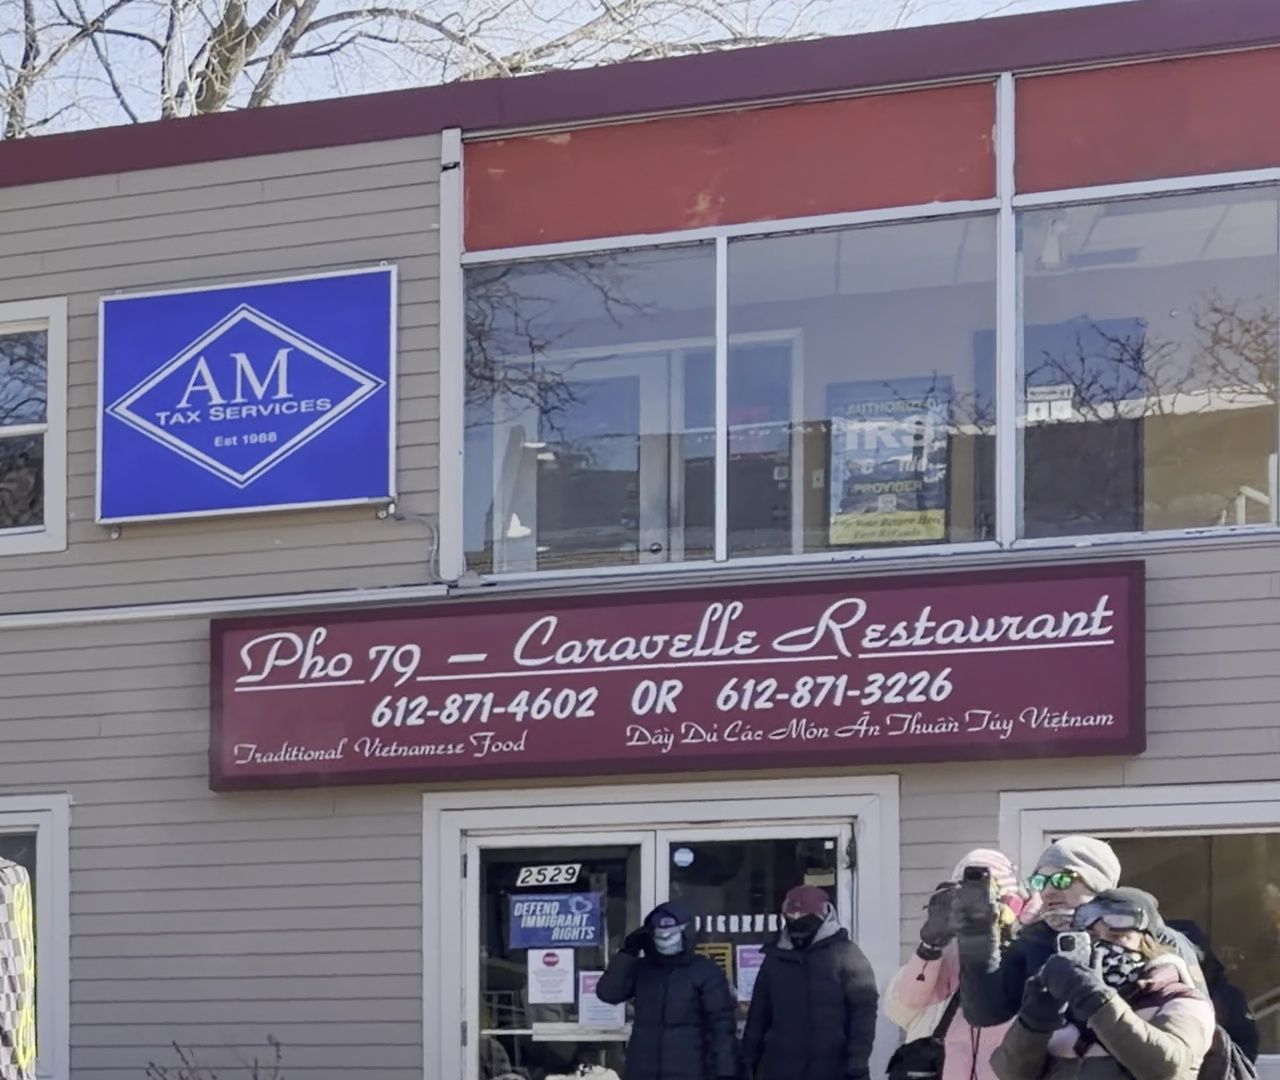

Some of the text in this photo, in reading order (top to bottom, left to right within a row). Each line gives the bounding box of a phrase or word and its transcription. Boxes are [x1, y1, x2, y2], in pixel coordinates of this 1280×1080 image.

[176, 347, 294, 408] AM
[155, 398, 332, 426] TAX SERVICES
[214, 432, 277, 447] Est 1988
[236, 627, 354, 684] Pho
[368, 643, 421, 687] 79
[512, 602, 760, 667] Caravelle
[772, 594, 1115, 657] Restaurant
[371, 667, 953, 728] 612-871-4602 OR 612-871-3226
[234, 736, 346, 764] Traditional
[354, 736, 465, 759] Vietnamese
[470, 730, 528, 758] Food
[723, 719, 764, 742] Các
[767, 717, 830, 741] Món
[965, 708, 1014, 740] Túy
[520, 866, 577, 884] 2529
[514, 902, 560, 916] DEFEND
[521, 914, 590, 928] IMMIGRANT
[551, 926, 596, 940] RIGHTS
